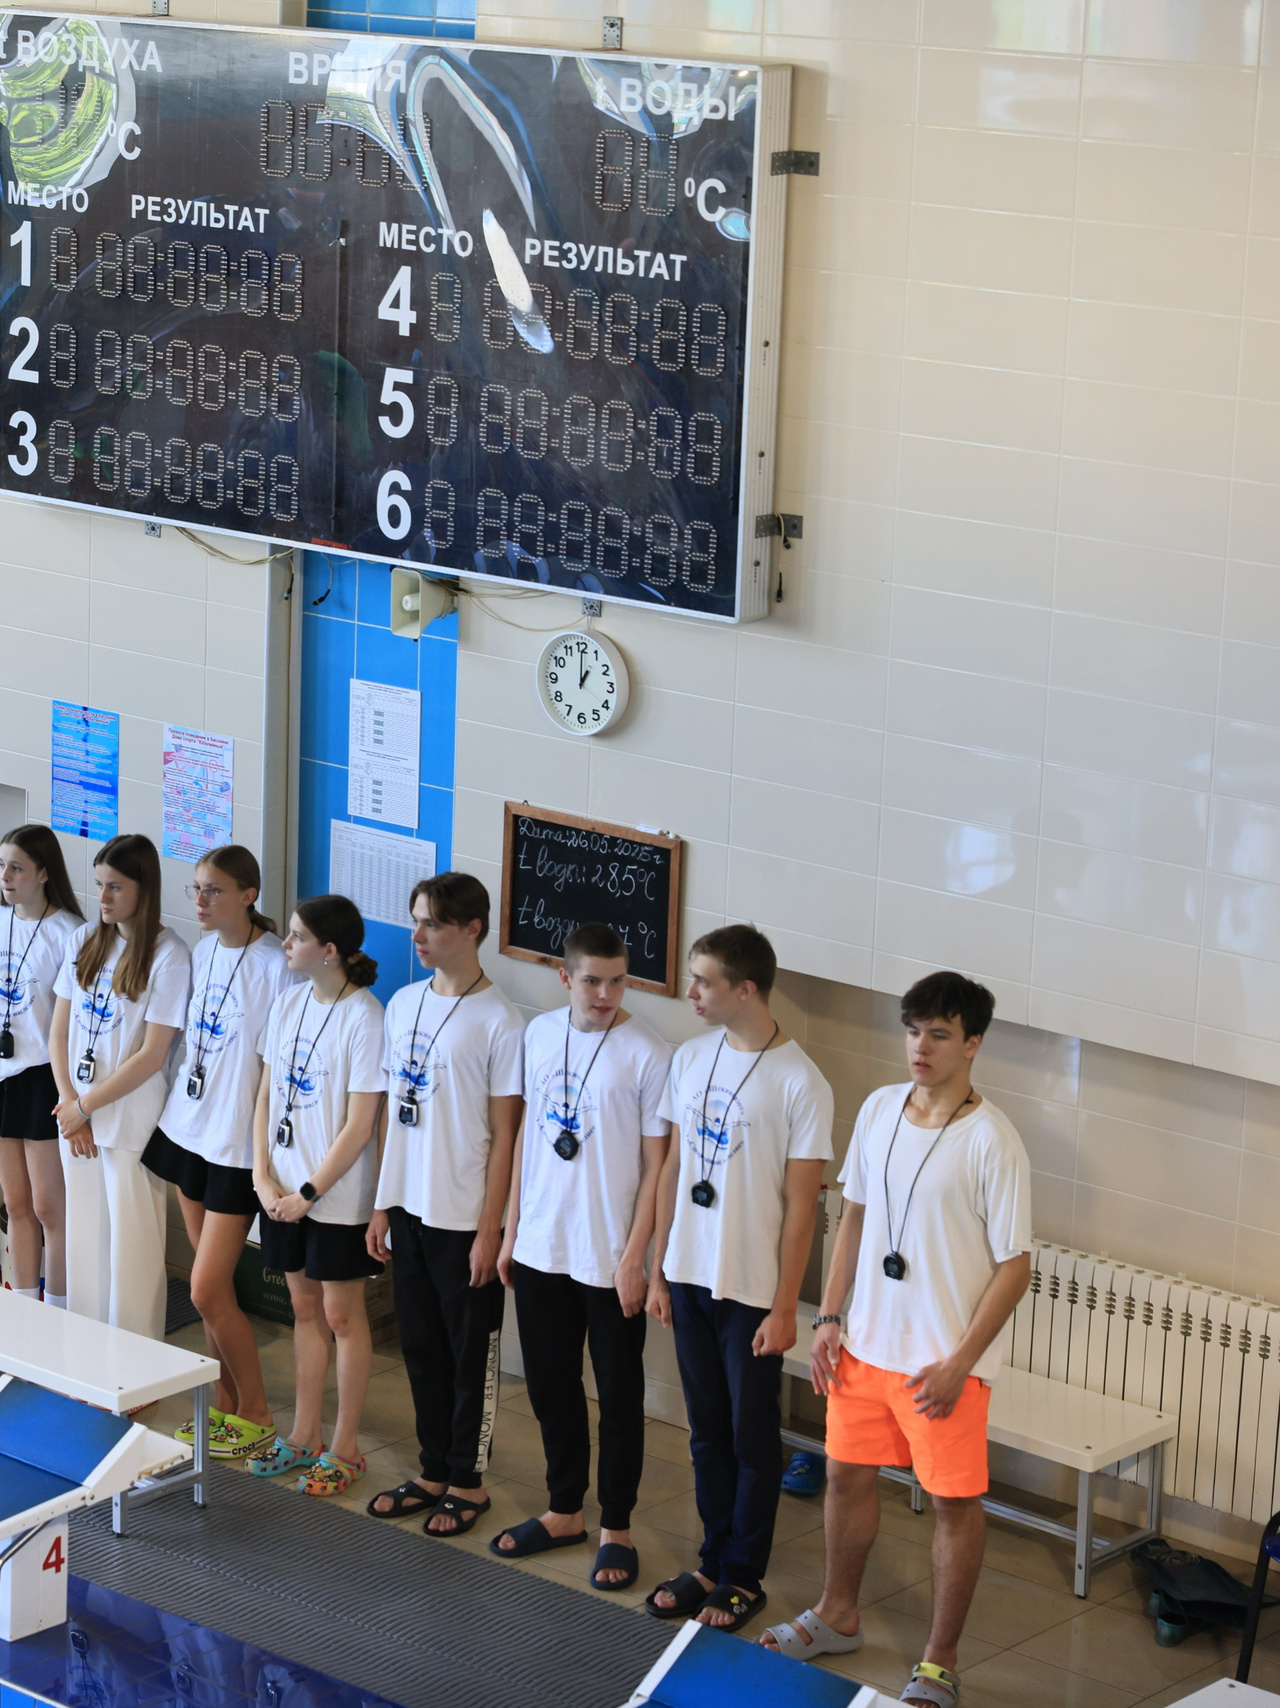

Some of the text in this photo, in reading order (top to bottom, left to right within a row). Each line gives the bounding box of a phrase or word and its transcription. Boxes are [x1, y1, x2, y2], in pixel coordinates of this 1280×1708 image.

[17, 29, 163, 73] ВОЗДУХА
[288, 52, 408, 94] ВРЯ
[620, 77, 736, 125] ВОДЫ
[8, 180, 271, 234] МЕСТО РЕЗУЛЬТАТ
[10, 221, 32, 287] 1
[379, 222, 688, 282] МЕСТО РЕЗУЛЬТАТ
[377, 265, 418, 337] 4
[8, 317, 39, 384] 2
[377, 367, 415, 439] 5
[7, 411, 39, 477] 3
[376, 469, 412, 541] 6
[564, 645, 573, 657] 11
[576, 641, 588, 654] 12
[593, 650, 598, 661] 1
[553, 655, 566, 668] 10
[601, 664, 610, 676] 2
[549, 672, 558, 684] 9
[606, 681, 615, 694] 3
[554, 690, 563, 702] 8
[601, 699, 610, 711] 4
[565, 704, 573, 716] 7
[577, 712, 587, 724] 6
[592, 709, 600, 721] 5
[263, 1267, 287, 1286] Gree
[232, 1442, 256, 1455] crocs
[474, 1411, 492, 1471] MONCLE
[42, 1535, 65, 1574] 4
